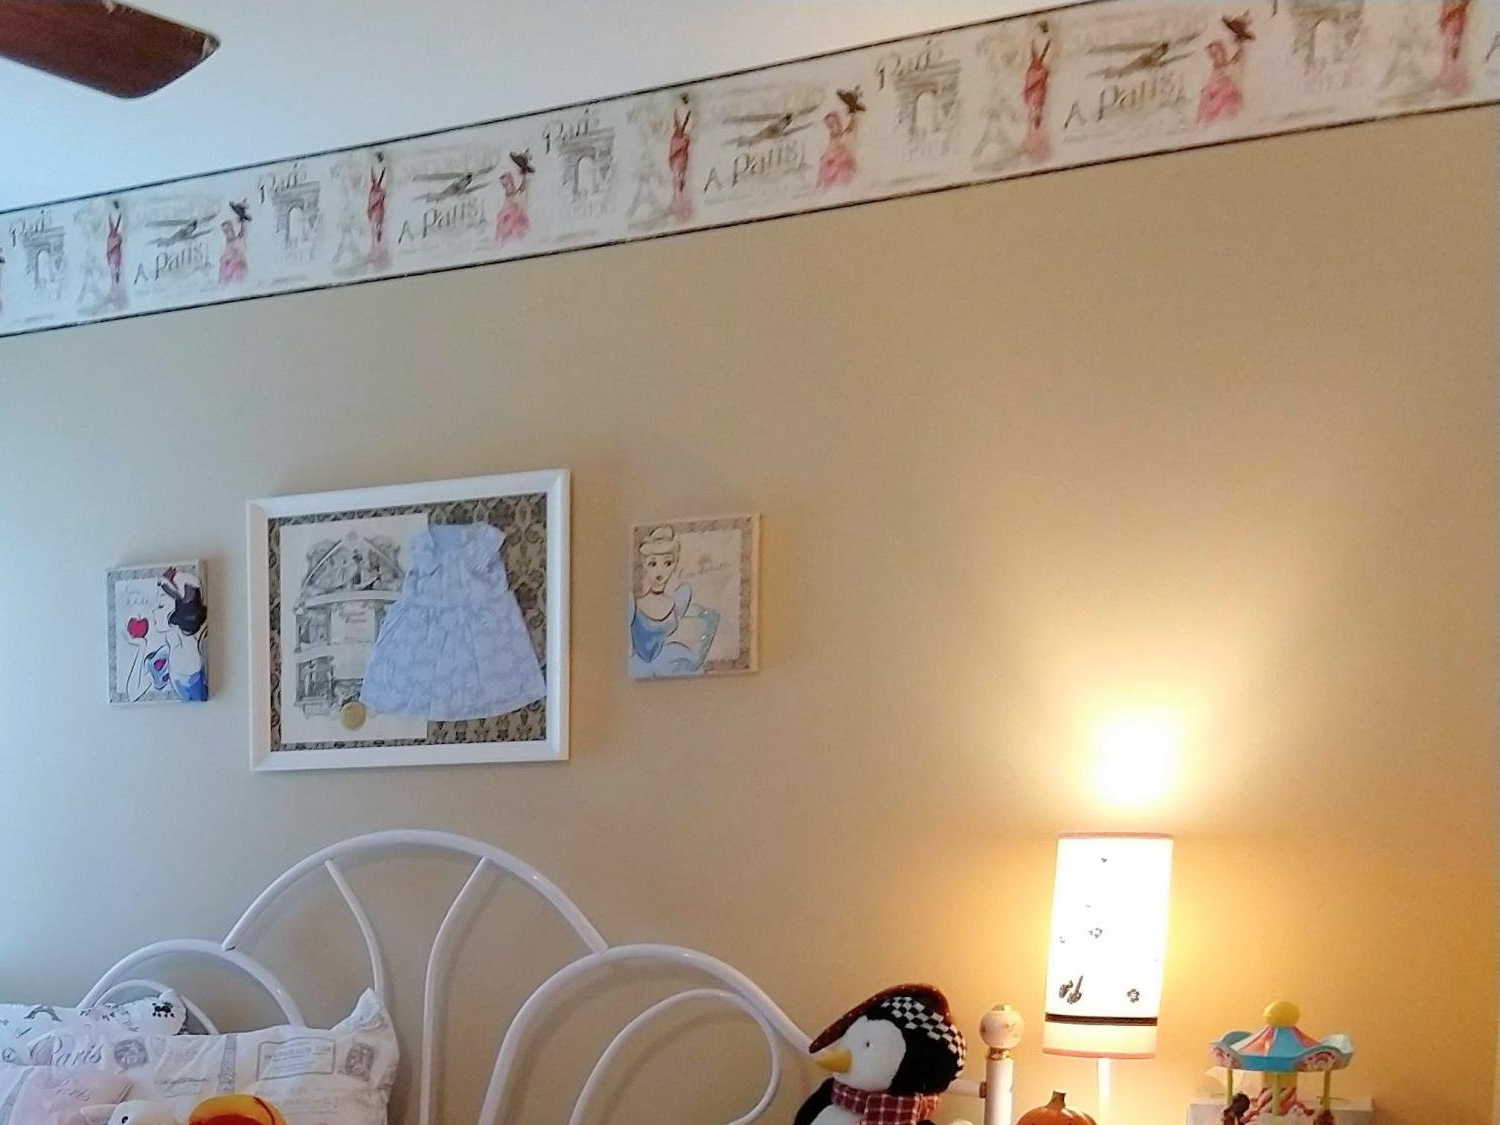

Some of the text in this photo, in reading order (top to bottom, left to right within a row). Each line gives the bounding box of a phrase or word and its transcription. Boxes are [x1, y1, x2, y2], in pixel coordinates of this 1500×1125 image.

[1064, 101, 1087, 129] A
[703, 168, 722, 192] A
[398, 220, 414, 244] A
[134, 263, 149, 285] A
[28, 1034, 104, 1066] Paris
